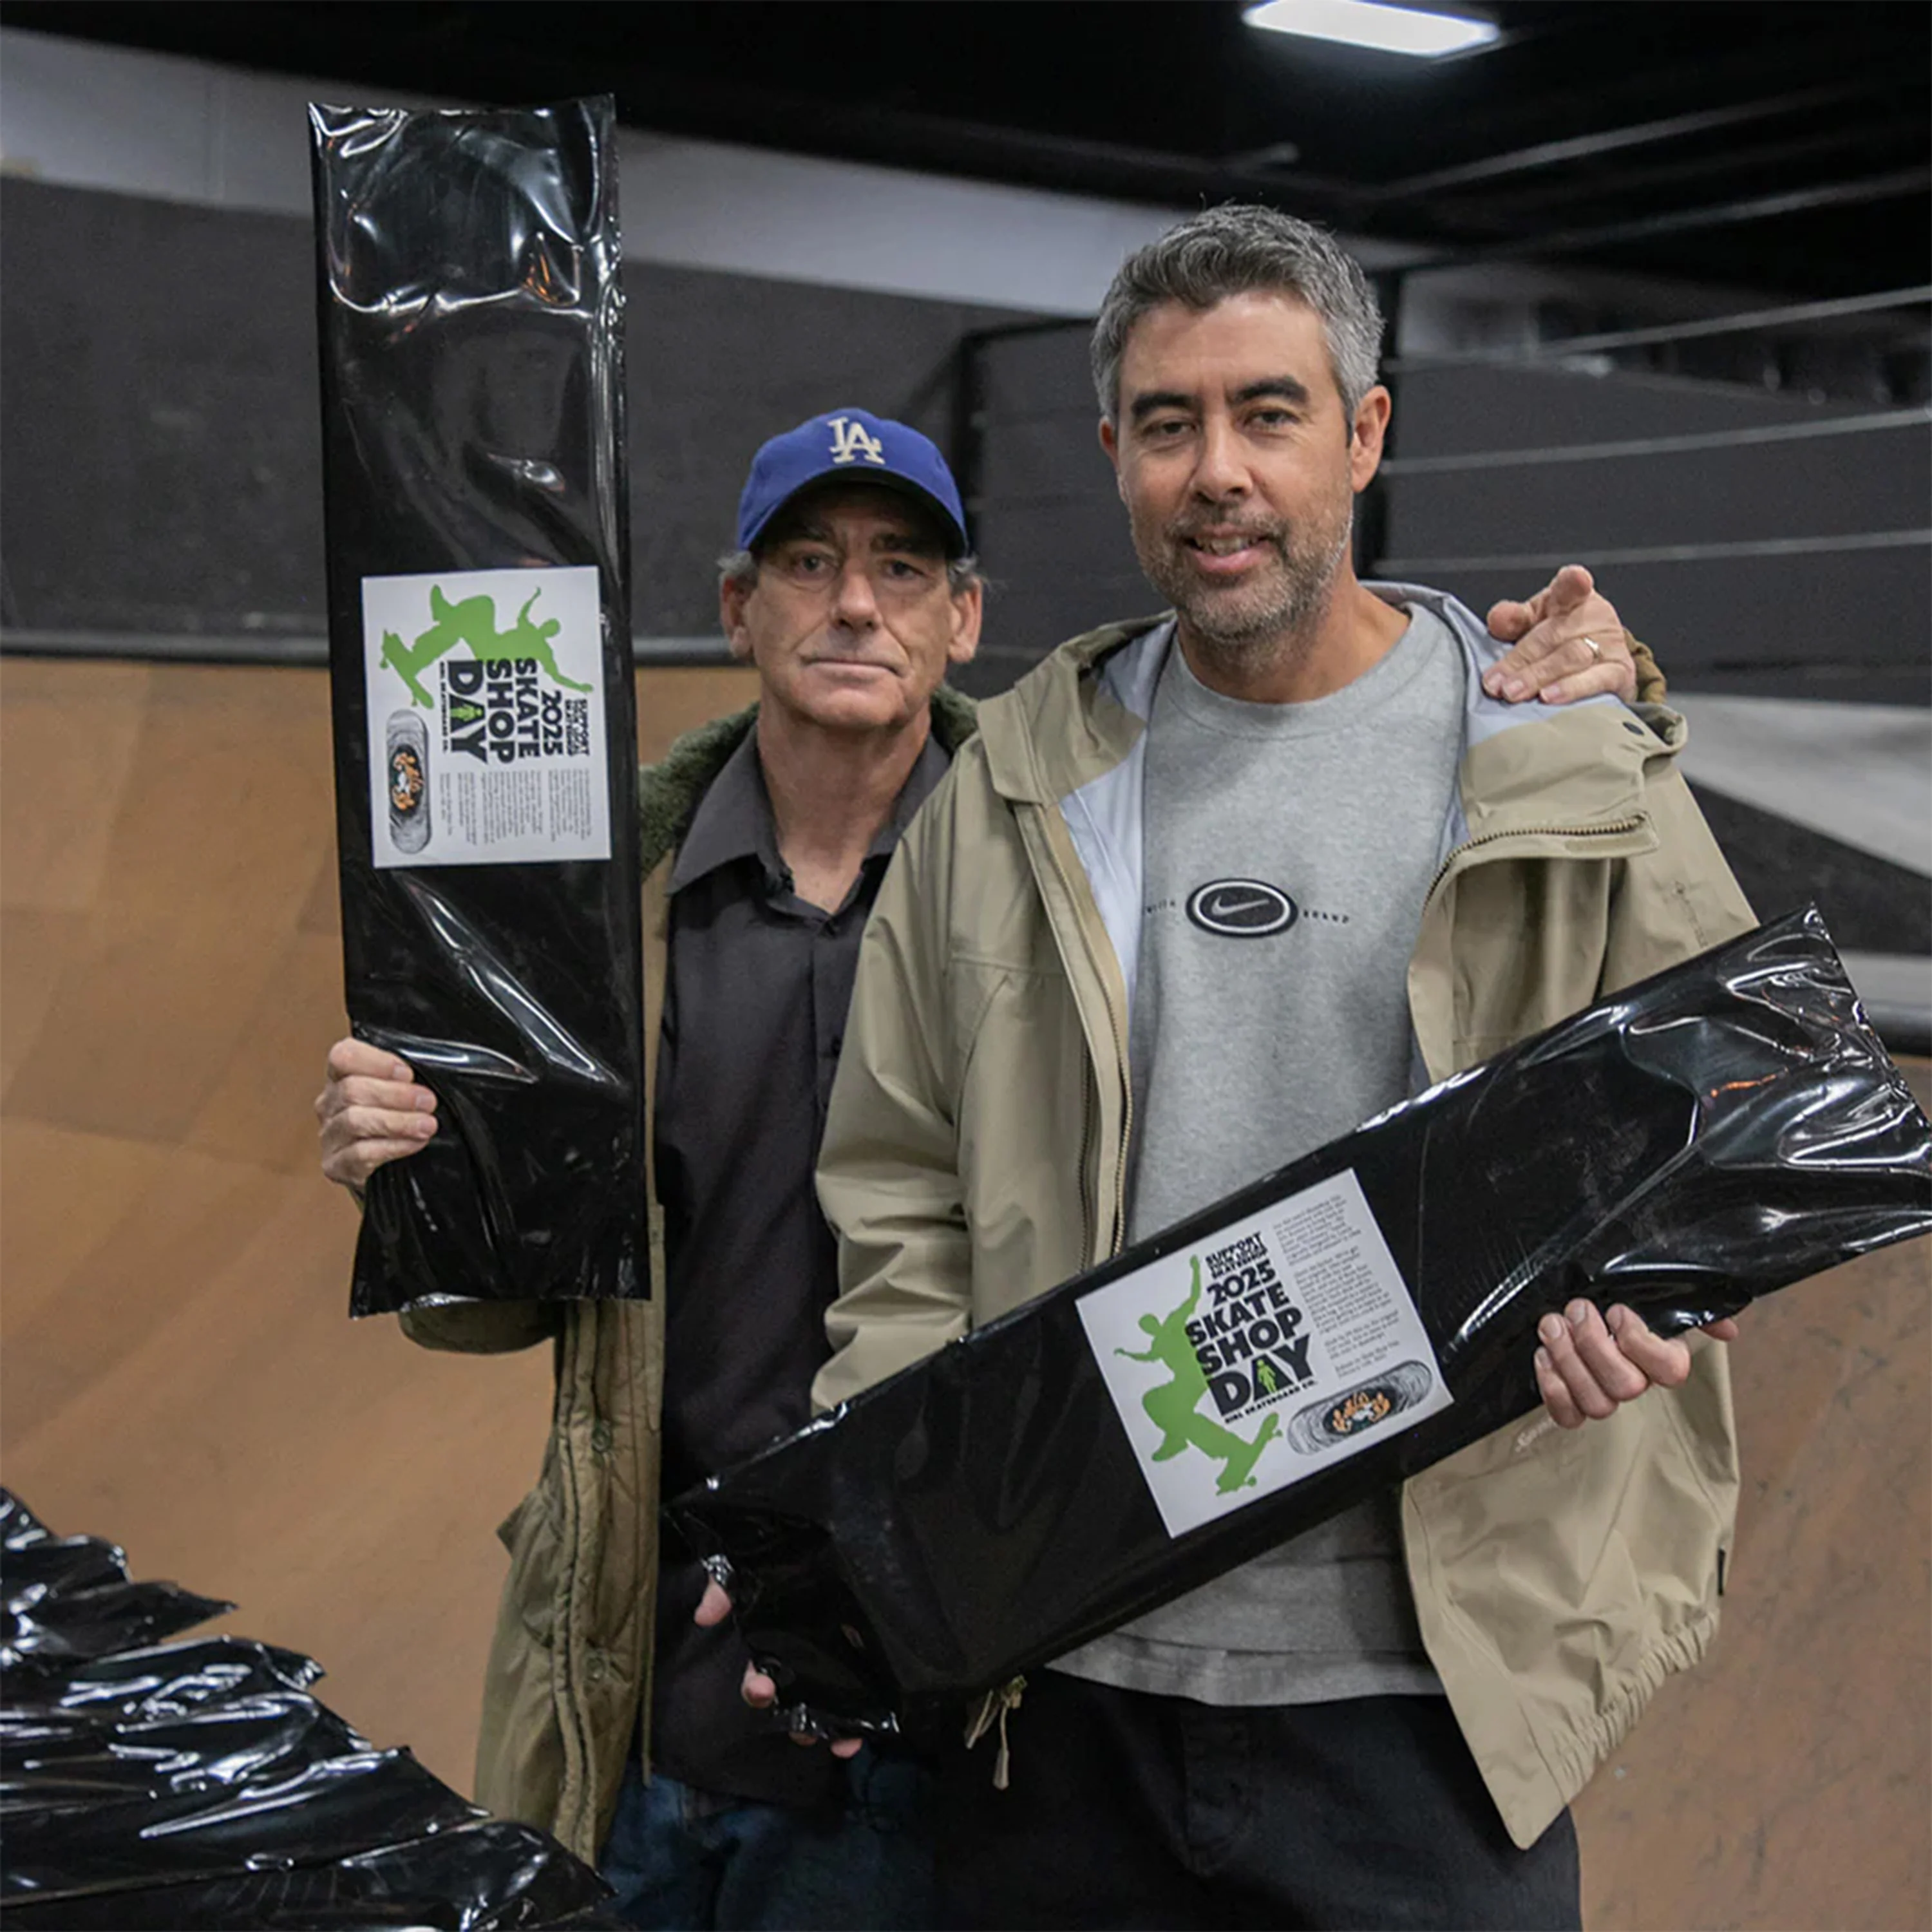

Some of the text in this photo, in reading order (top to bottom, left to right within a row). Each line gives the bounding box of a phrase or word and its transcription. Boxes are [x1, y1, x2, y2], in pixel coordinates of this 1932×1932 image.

[828, 416, 886, 464] LA
[448, 659, 487, 762] DAY
[486, 659, 515, 762] SHOP
[515, 658, 539, 757] SKATE
[542, 691, 562, 755] 2025
[579, 698, 591, 756] SUPPORT
[1205, 1231, 1262, 1265] SUPPORT
[1185, 1282, 1289, 1347] SKATE
[1208, 1259, 1275, 1306] 2025
[1196, 1307, 1302, 1376] SHOP
[1207, 1334, 1312, 1416] DAY
